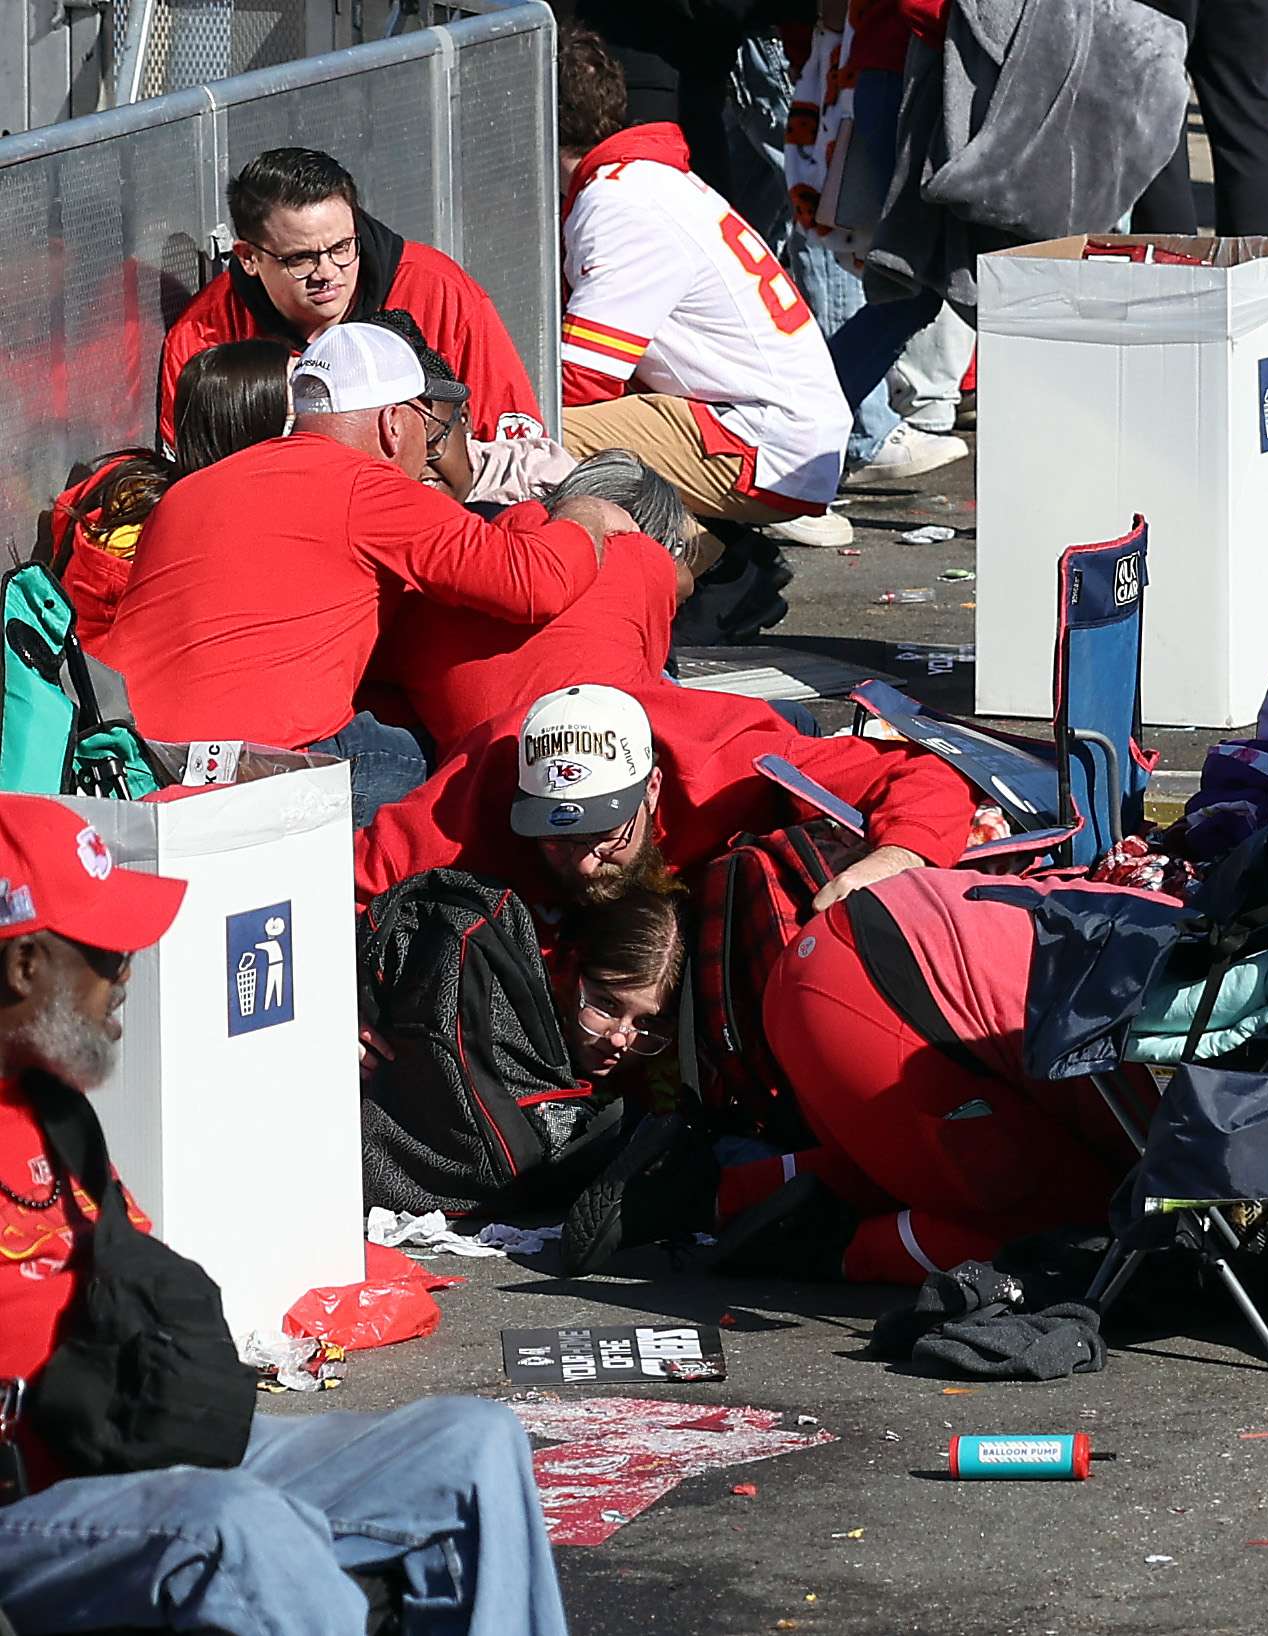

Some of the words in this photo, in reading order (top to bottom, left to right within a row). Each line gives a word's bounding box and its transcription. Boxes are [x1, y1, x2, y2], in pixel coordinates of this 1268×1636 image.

[541, 726, 565, 734] SUPER
[525, 730, 617, 767] CHAMPIONS
[561, 1355, 596, 1382] YOUR
[982, 1447, 1028, 1456] BALLOON
[1030, 1447, 1059, 1456] PUMP
